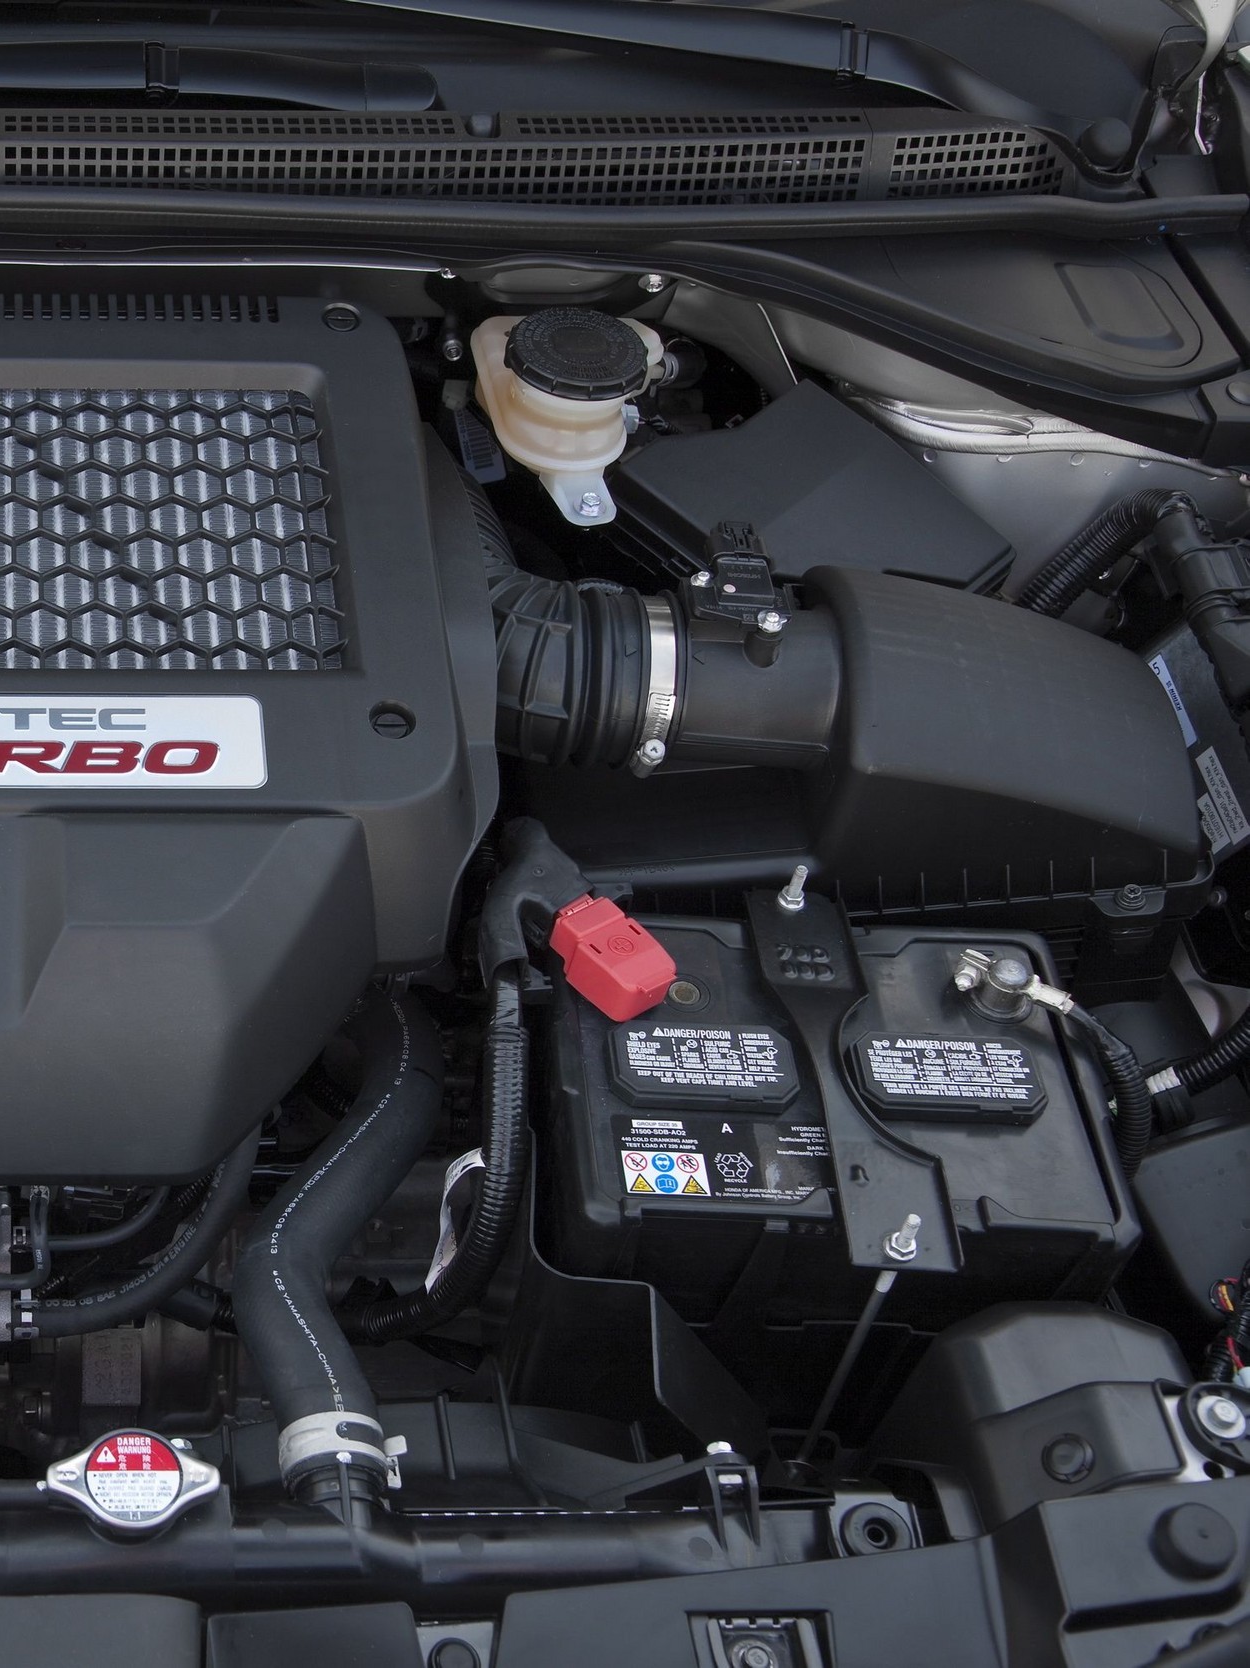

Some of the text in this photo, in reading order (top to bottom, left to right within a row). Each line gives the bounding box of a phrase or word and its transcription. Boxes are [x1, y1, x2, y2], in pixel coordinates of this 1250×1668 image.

[663, 1028, 731, 1040] DANGER/POISON
[905, 1039, 976, 1050] DANGER/POISON
[721, 1123, 733, 1134] A
[117, 1437, 151, 1446] DANGER
[117, 1446, 151, 1454] WARNUNG
